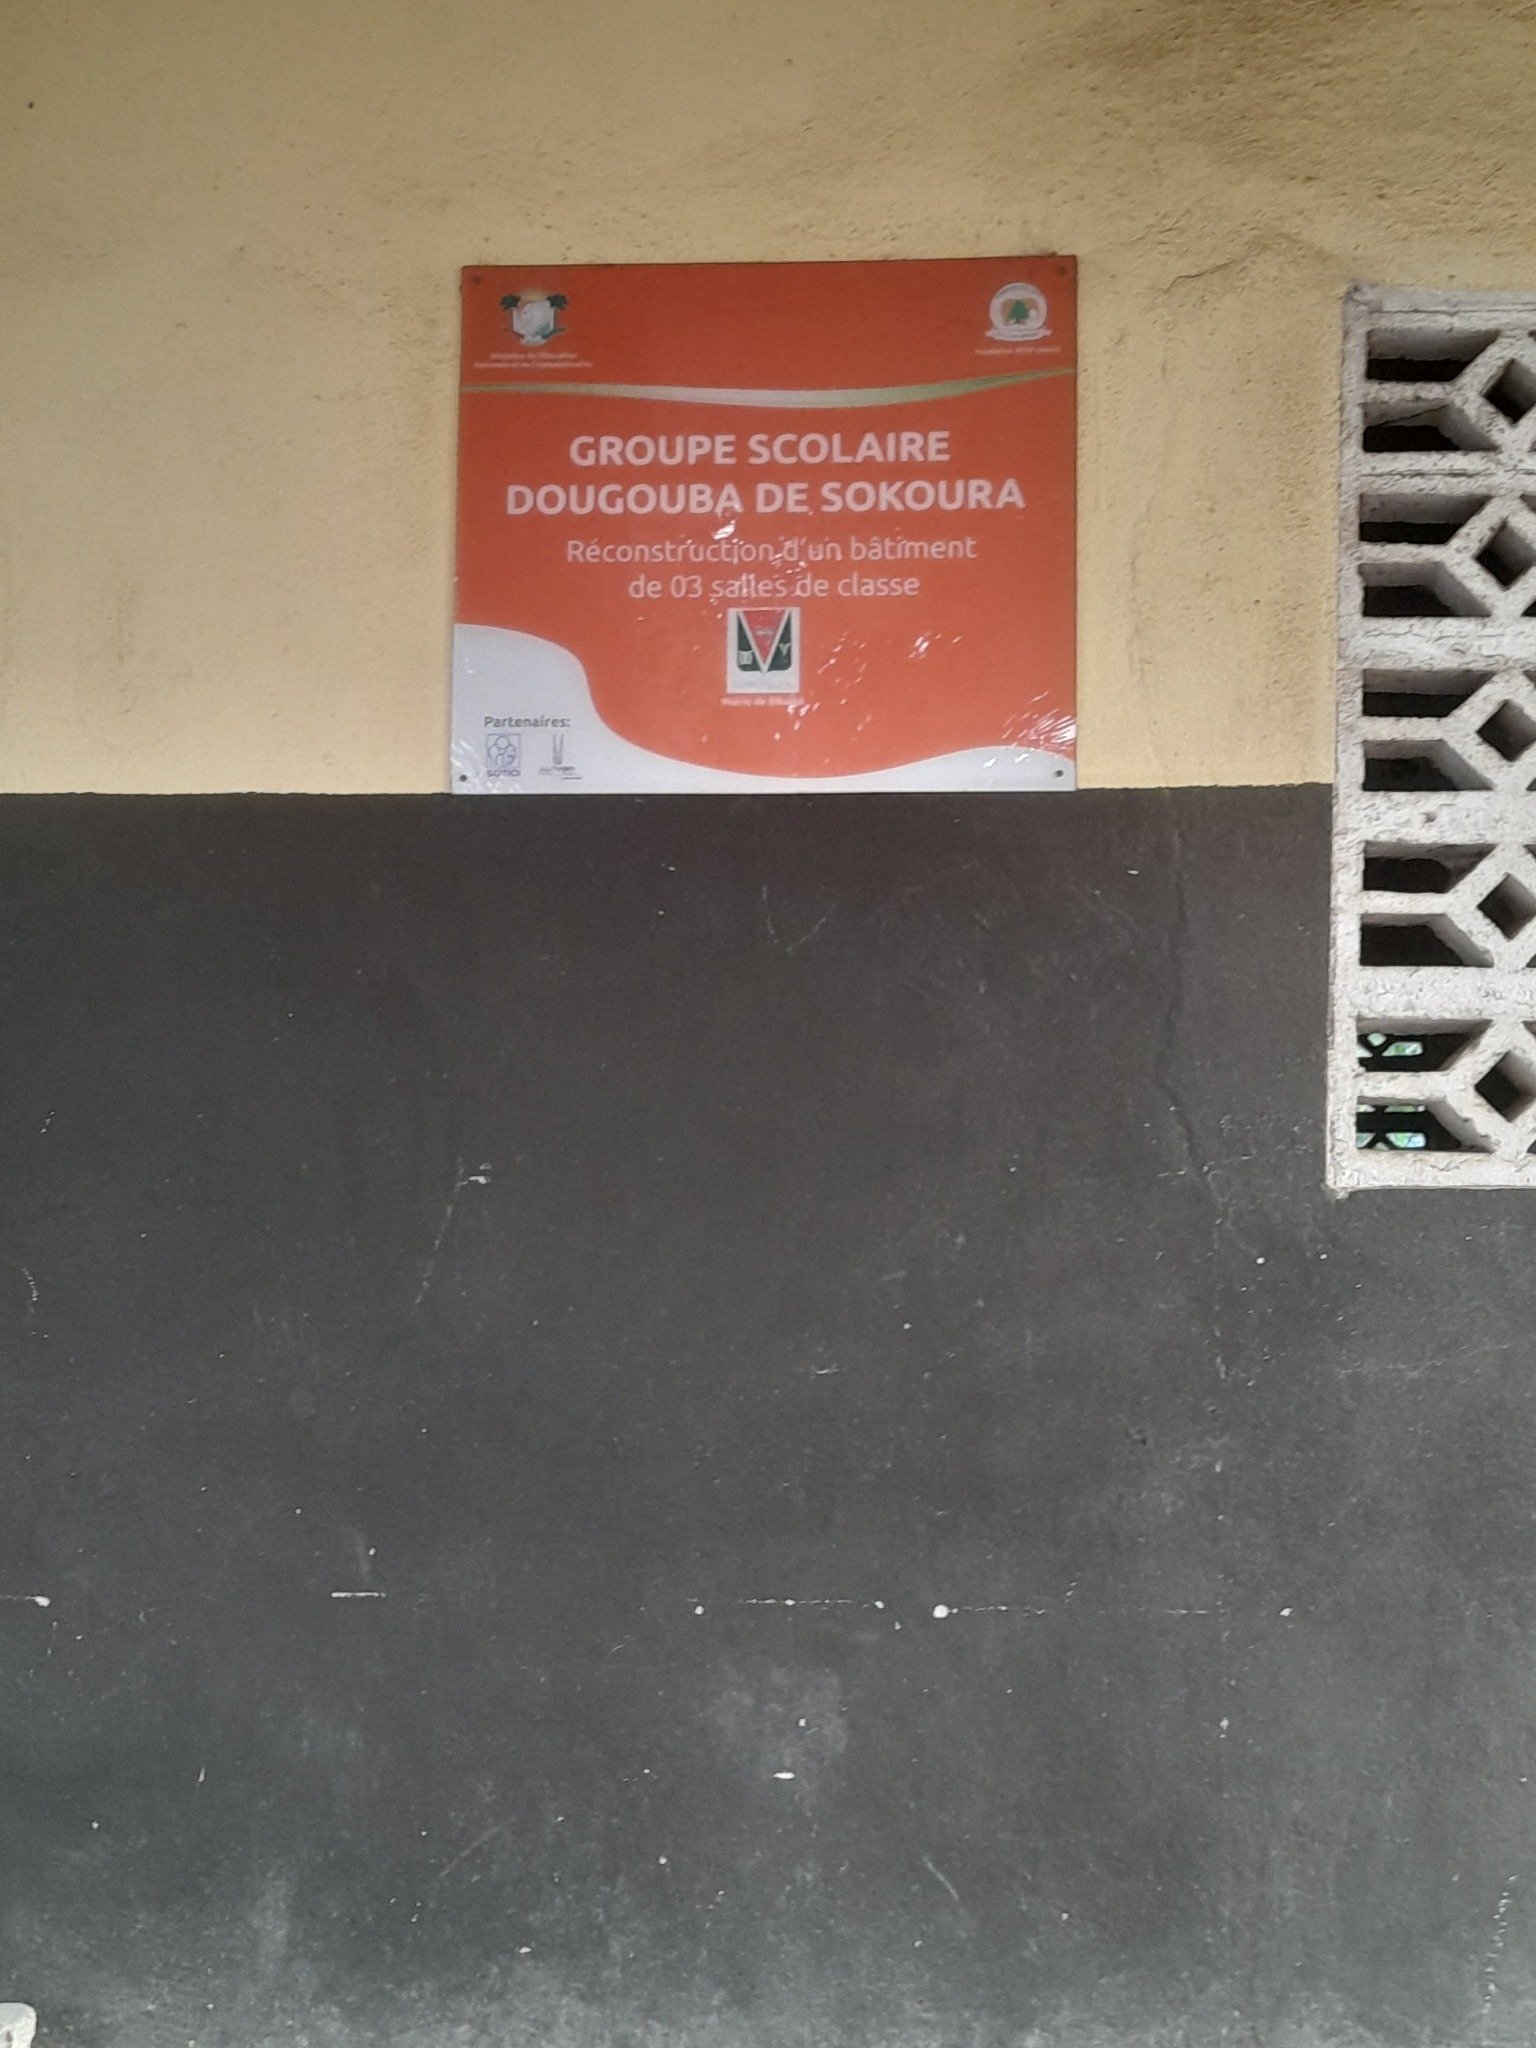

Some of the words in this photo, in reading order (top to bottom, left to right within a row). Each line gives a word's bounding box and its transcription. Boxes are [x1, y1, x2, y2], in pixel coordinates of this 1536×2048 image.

[569, 435, 737, 467] GROUPE
[748, 430, 951, 465] SCOLAIRE
[506, 482, 744, 516] DOUGOUBA
[755, 482, 810, 514] DE
[820, 477, 1026, 512] SOKOURA
[566, 538, 776, 563] Réconstruction
[782, 536, 842, 561] d'un
[850, 534, 978, 560] bâtiment
[628, 573, 663, 598] de
[670, 575, 703, 598] 03
[710, 573, 788, 598] salles
[795, 571, 830, 597] de
[837, 571, 920, 597] classe
[484, 715, 572, 728] Partenaires:
